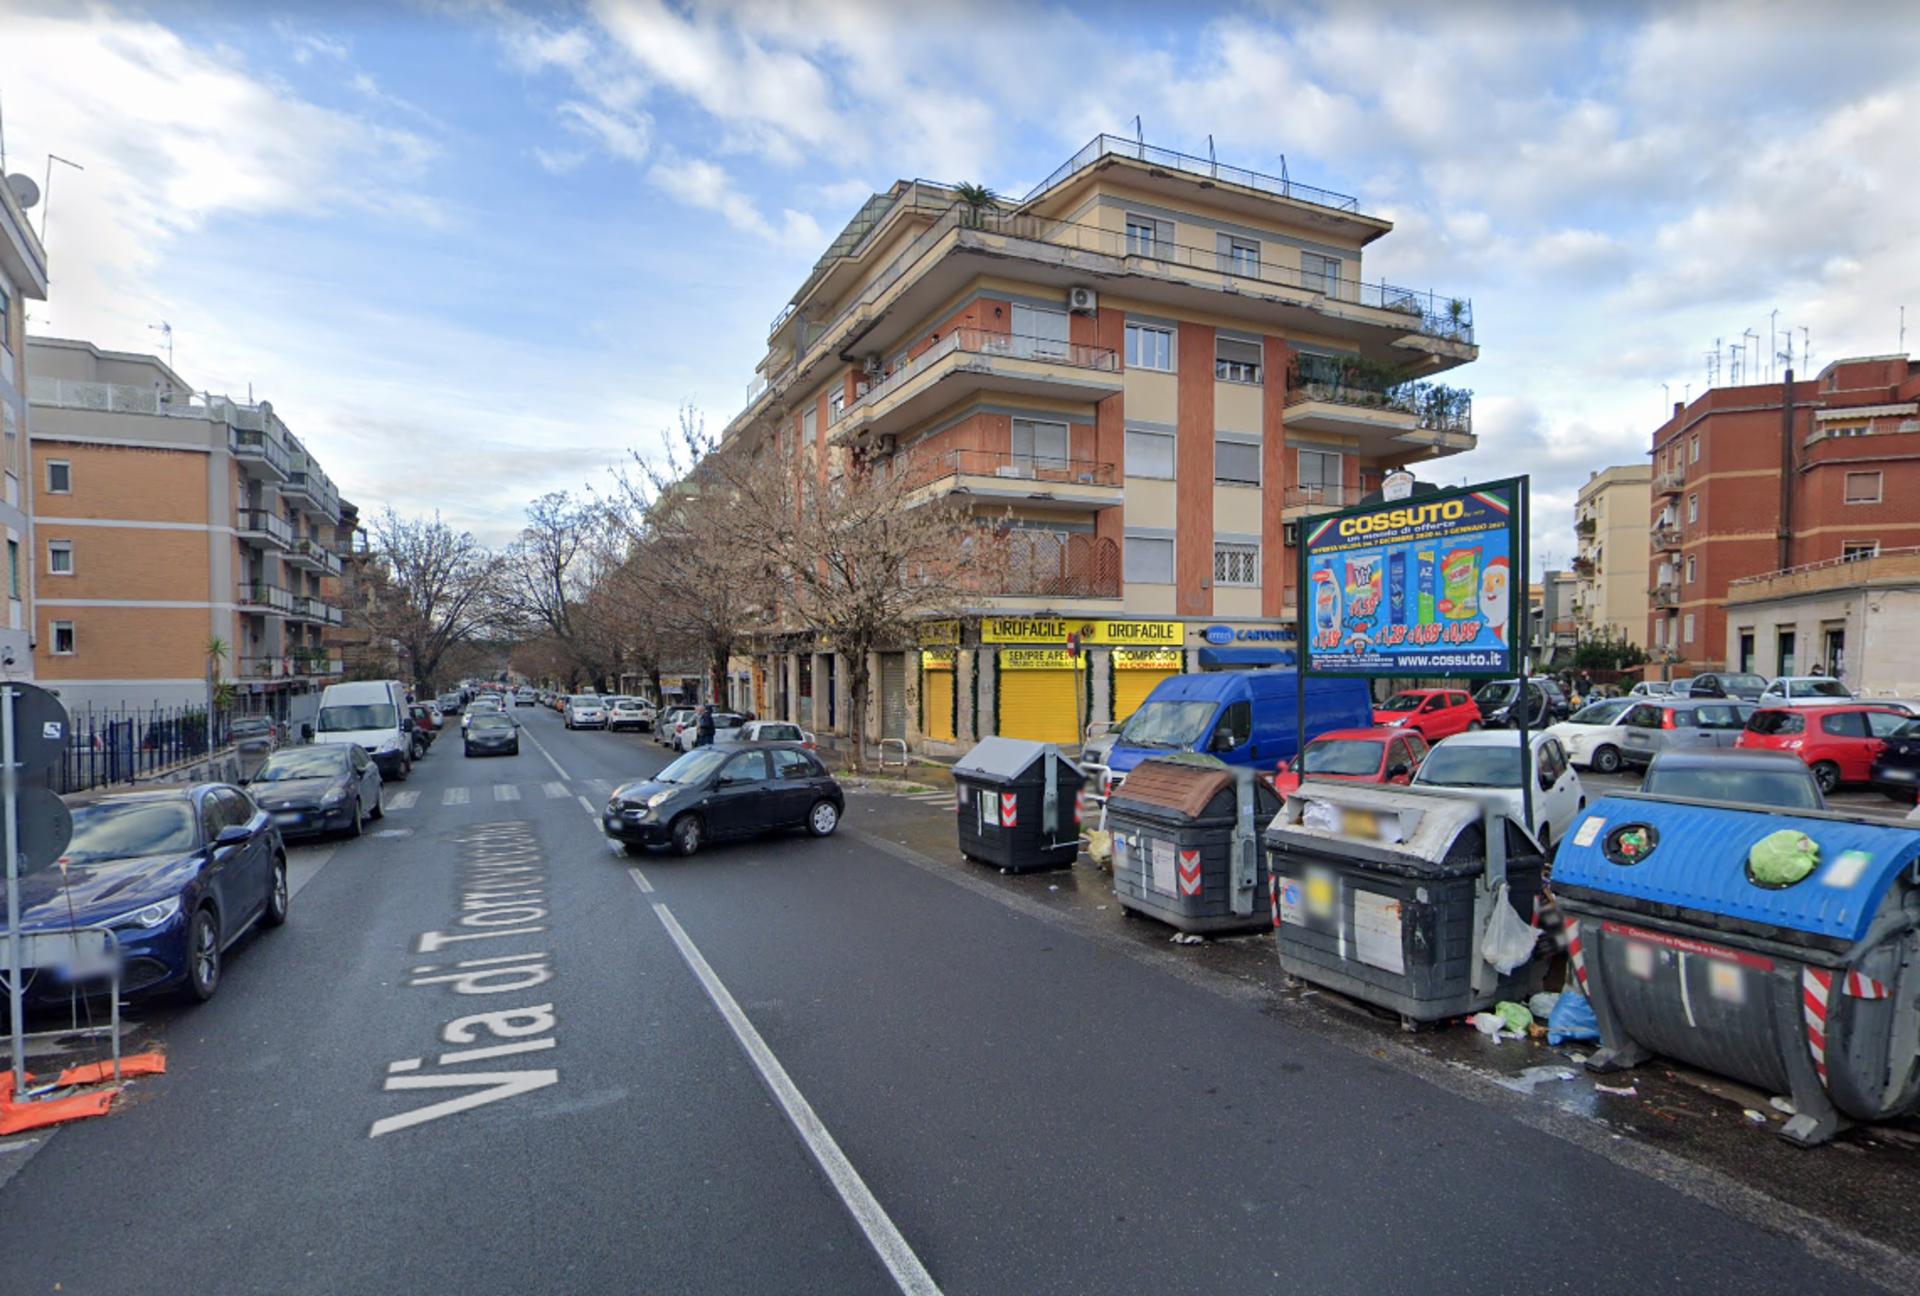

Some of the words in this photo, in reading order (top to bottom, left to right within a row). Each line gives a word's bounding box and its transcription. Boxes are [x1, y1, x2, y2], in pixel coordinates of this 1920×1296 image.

[1339, 499, 1464, 538] COSSUTO
[1347, 534, 1358, 543] un
[1401, 526, 1411, 536] di
[1414, 521, 1457, 534] offerte
[1379, 533, 1413, 546] DICEMBRE
[1414, 531, 1434, 541] 2020
[1450, 523, 1486, 536] GENNAIO
[1419, 566, 1433, 578] AZ
[1108, 623, 1174, 639] OROFACILE
[1009, 650, 1044, 661] SEMPRE
[1398, 651, 1502, 667] www.cossuto.it
